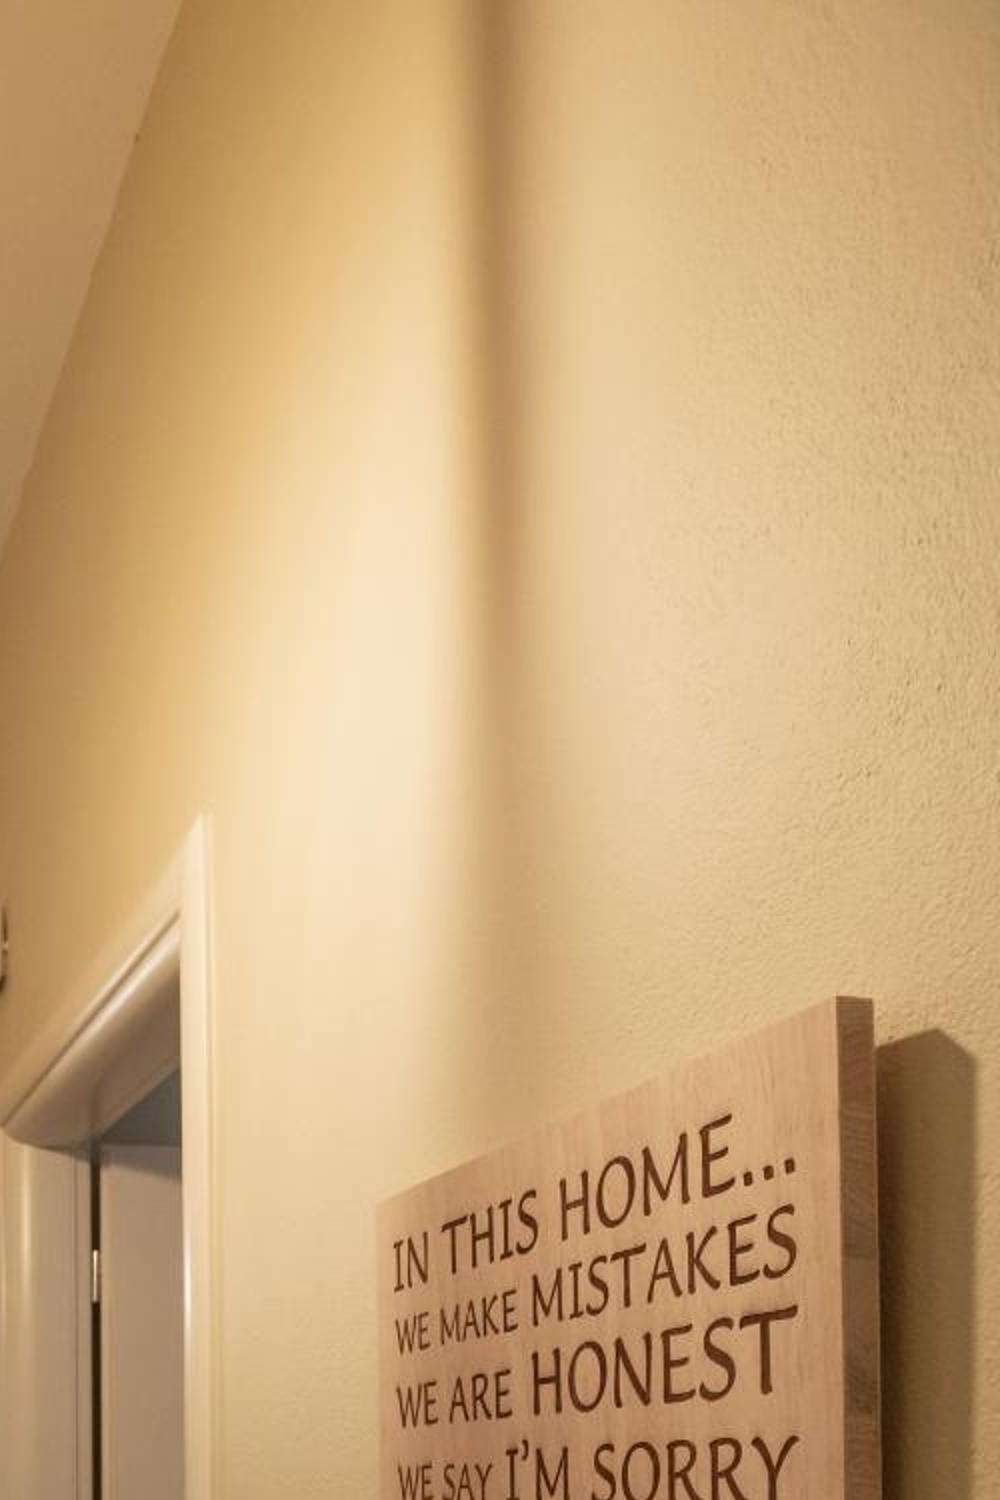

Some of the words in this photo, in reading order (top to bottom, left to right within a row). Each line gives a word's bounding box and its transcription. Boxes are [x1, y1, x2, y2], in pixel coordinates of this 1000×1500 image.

[393, 1231, 429, 1293] IN
[440, 1188, 539, 1276] THIS
[559, 1113, 796, 1242] HOME...
[394, 1311, 431, 1355] WE
[439, 1288, 519, 1346] MAKE
[531, 1203, 798, 1328] MISTAKES
[395, 1380, 439, 1429] WE
[448, 1368, 513, 1425] ARE
[531, 1303, 799, 1417] HONEST
